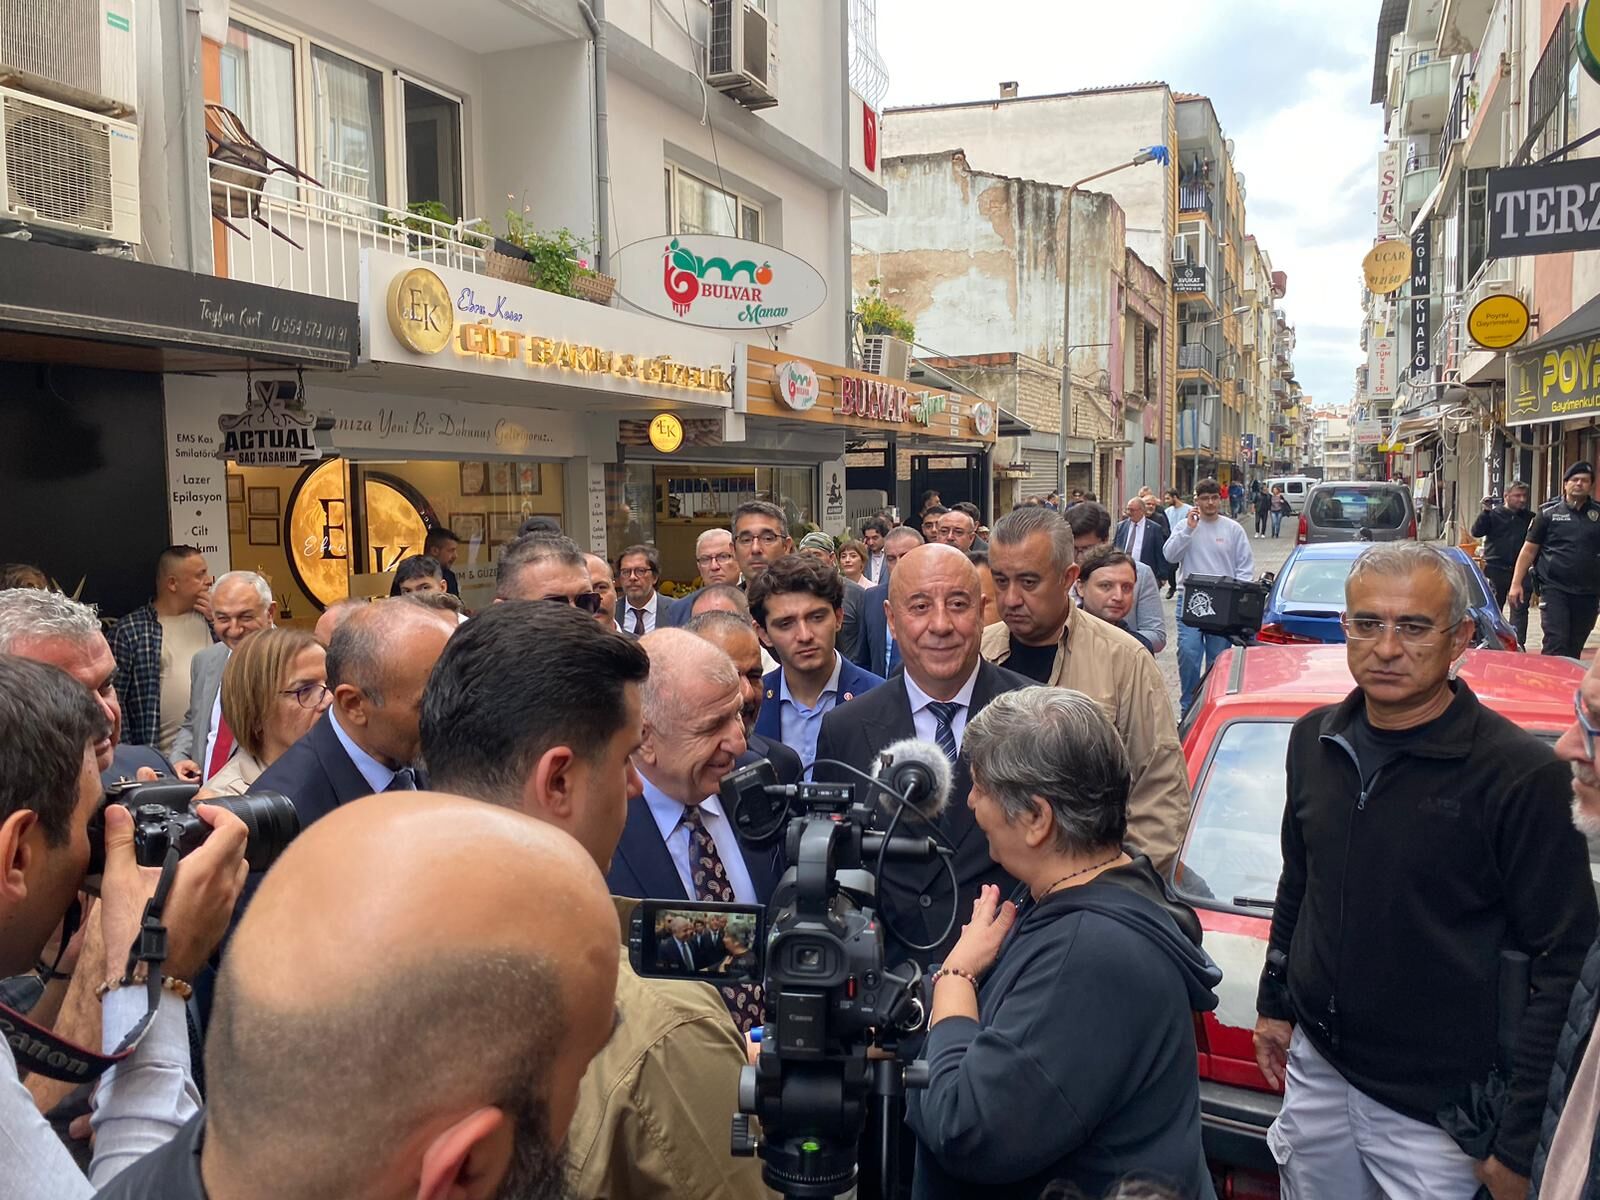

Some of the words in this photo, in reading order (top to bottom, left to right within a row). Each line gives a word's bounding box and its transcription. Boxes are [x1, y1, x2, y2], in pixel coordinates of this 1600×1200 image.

[701, 283, 762, 302] BULVAR
[738, 303, 788, 324] Manav
[841, 376, 908, 423] BULVAR
[1552, 396, 1595, 413] Gayrimenkul
[378, 407, 409, 439] Yeni
[412, 410, 434, 435] Bir
[176, 433, 195, 443] EMS
[198, 434, 213, 443] Kas
[224, 428, 315, 452] ACTUAL
[239, 451, 255, 464] SAÇ
[257, 451, 297, 463] TASARIM
[183, 474, 211, 485] Lazer
[173, 491, 222, 504] Epilasyon
[191, 525, 208, 537] Cilt
[195, 542, 218, 553] kımı
